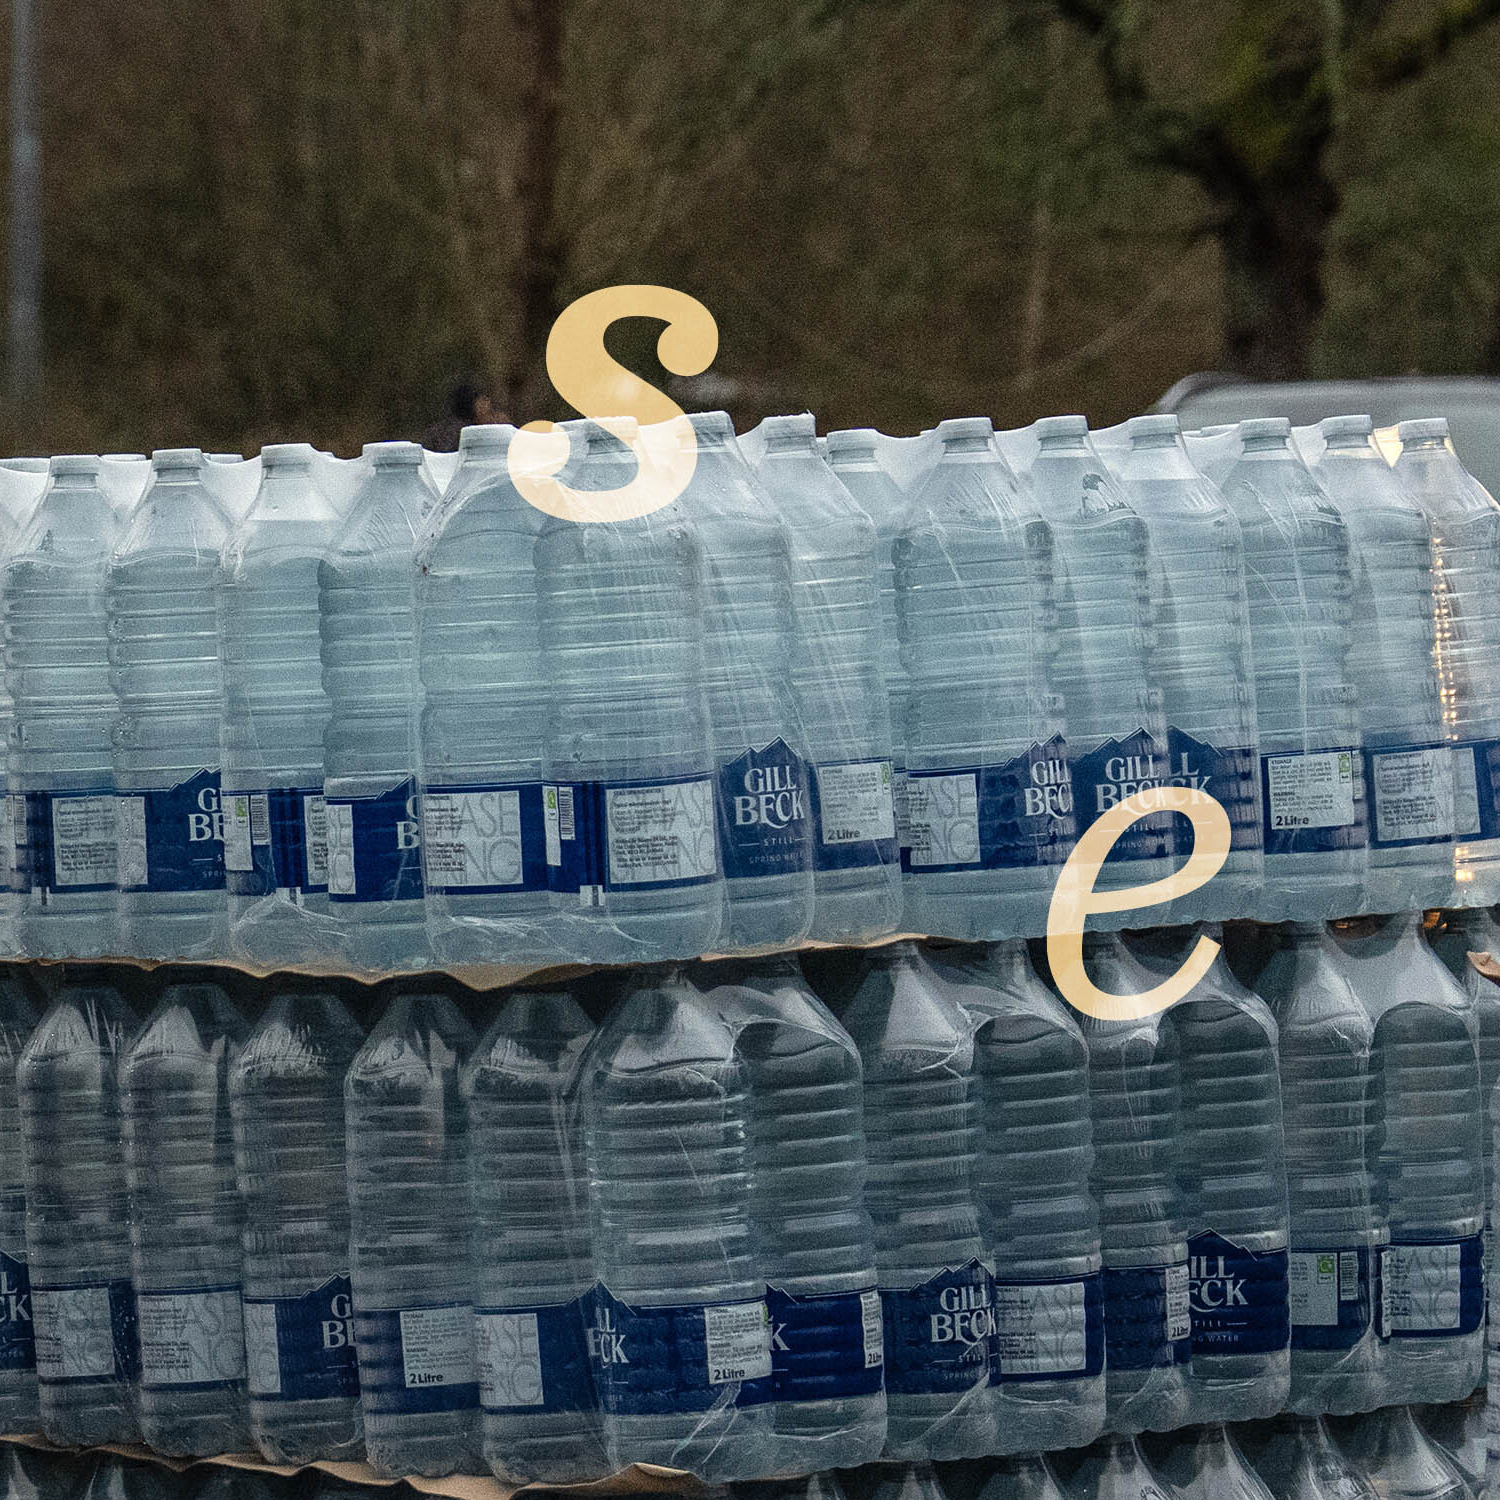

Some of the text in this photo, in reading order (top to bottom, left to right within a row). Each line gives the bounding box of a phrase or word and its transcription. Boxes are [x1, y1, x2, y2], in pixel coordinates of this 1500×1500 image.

[1105, 755, 1160, 782] GILL
[744, 765, 797, 793] GILL
[733, 789, 805, 829] BECK
[1275, 815, 1309, 827] 2 Litre
[763, 836, 794, 847] STILL
[837, 829, 861, 840] Litre
[940, 1284, 992, 1312] GILL
[930, 1307, 997, 1346] BECK
[409, 1372, 444, 1385] 2 Litre
[714, 1368, 745, 1381] 2 Litre
